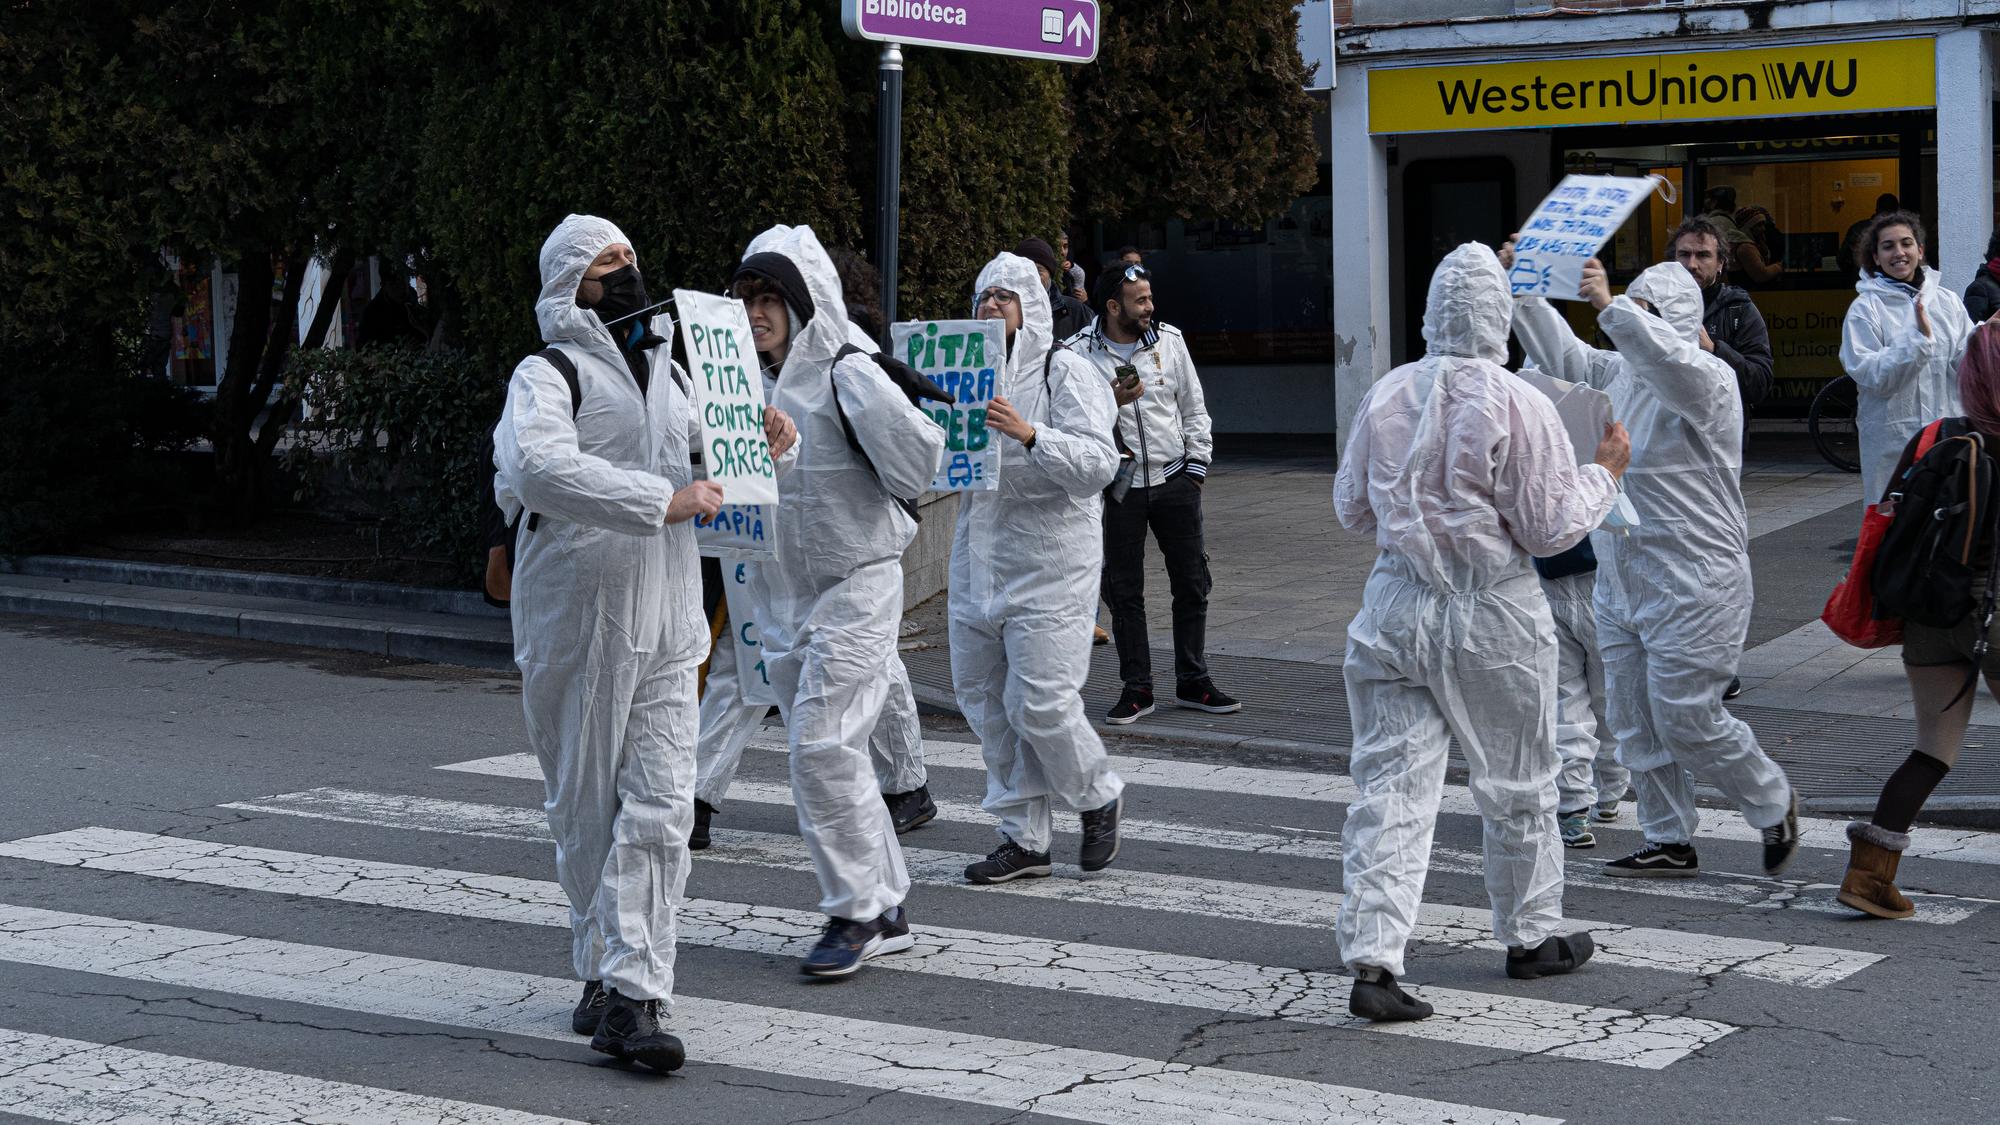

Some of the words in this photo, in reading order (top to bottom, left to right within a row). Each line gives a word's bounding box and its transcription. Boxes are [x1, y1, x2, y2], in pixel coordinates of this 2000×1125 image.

[866, 0, 967, 26] Biblioteca
[1437, 63, 1757, 115] WesternUnion
[690, 323, 739, 359] PITA
[702, 362, 751, 398] PITA
[705, 402, 766, 435] CONTRA
[712, 437, 774, 478] SAREB
